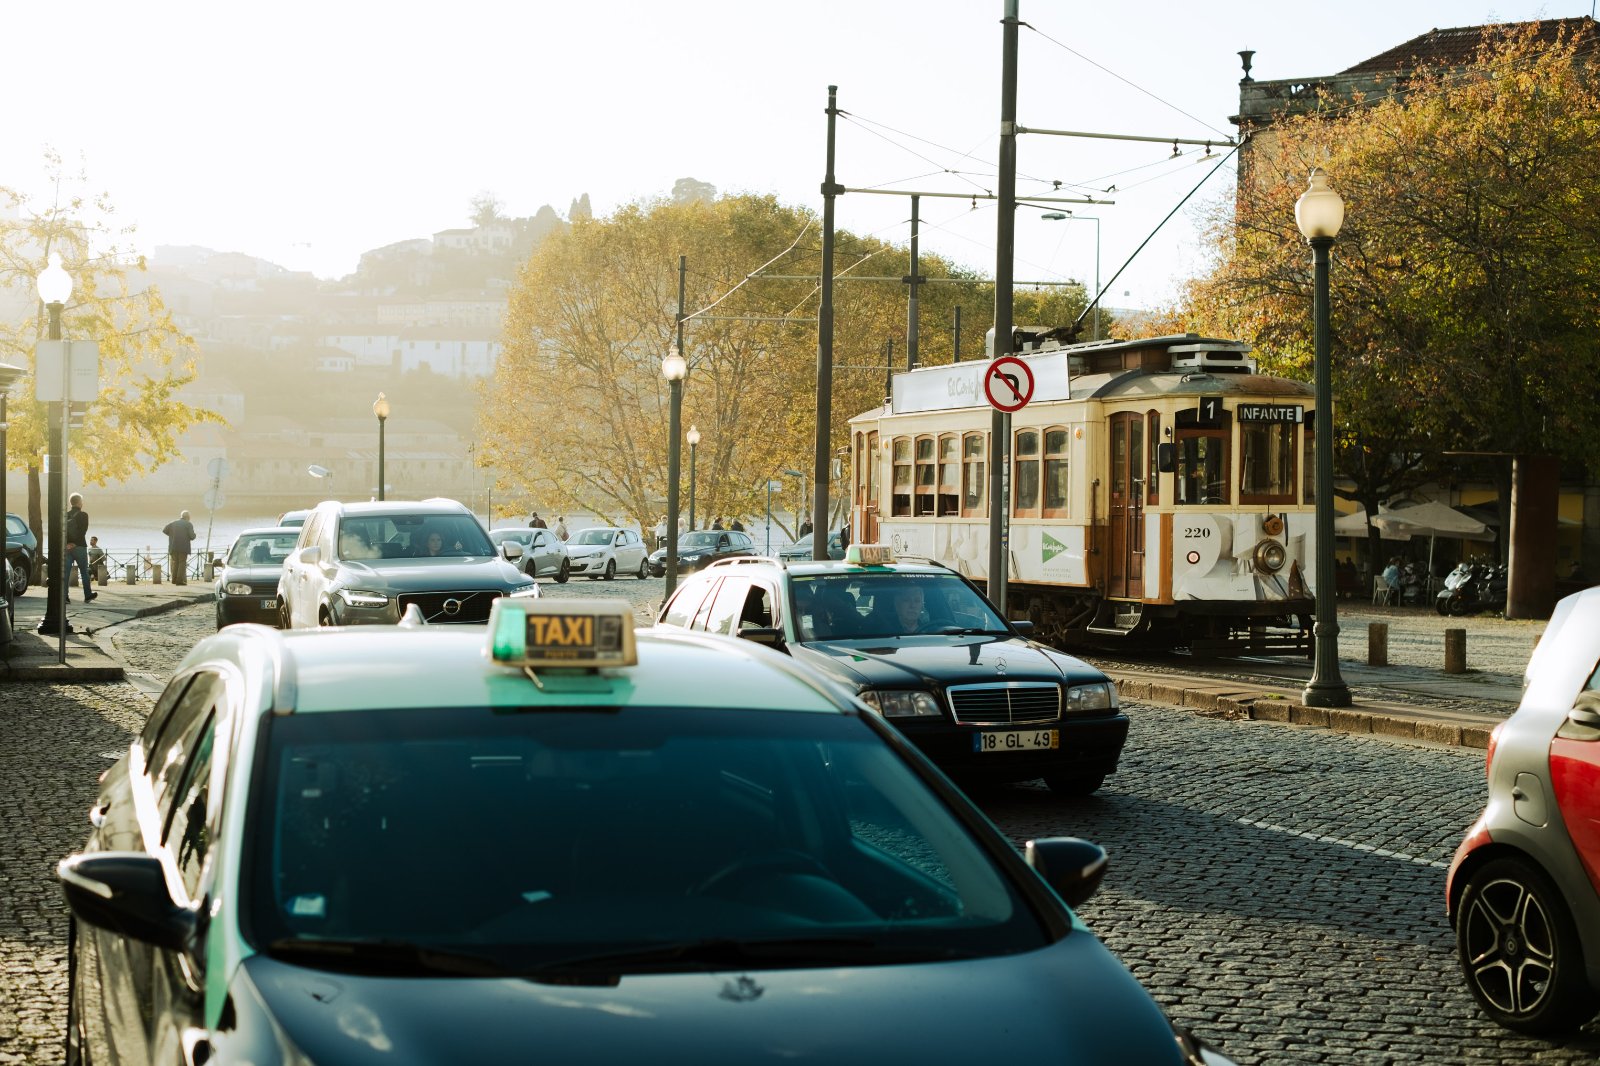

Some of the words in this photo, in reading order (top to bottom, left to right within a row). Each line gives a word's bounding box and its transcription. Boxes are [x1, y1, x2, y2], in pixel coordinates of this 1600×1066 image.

[1206, 401, 1214, 419] 1
[1184, 527, 1211, 538] 220
[861, 547, 881, 561] TAXI
[529, 616, 593, 646] TAXI
